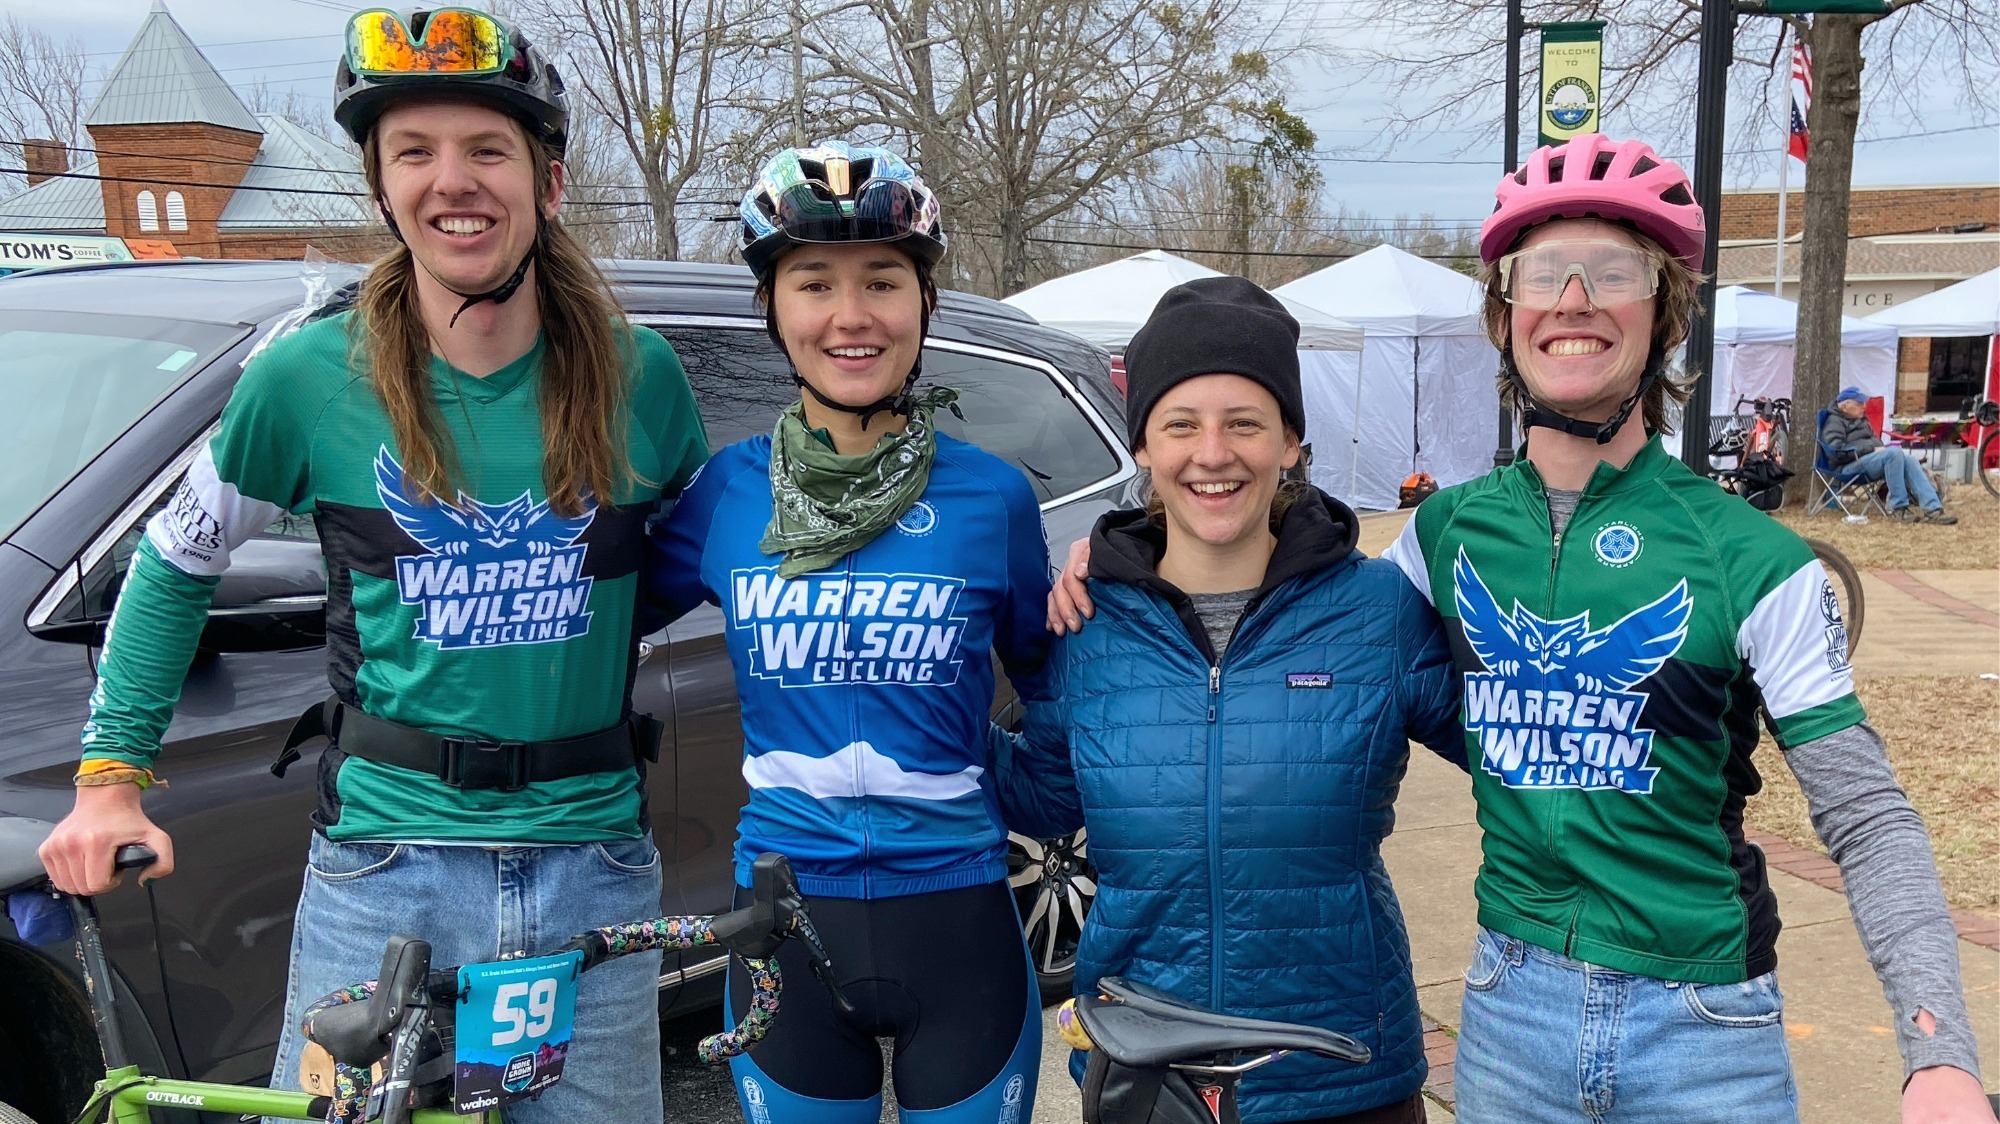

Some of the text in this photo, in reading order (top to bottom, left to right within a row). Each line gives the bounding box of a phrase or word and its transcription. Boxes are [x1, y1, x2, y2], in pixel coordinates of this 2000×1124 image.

[1547, 48, 1597, 56] WELCOME
[0, 242, 102, 261] TOM'S COFFEE
[1852, 293, 1894, 306] ICE
[180, 476, 225, 538] BERTY
[1597, 520, 1645, 541] STARLIGHT
[181, 547, 212, 562] 1980
[402, 552, 579, 598] WARREN
[735, 573, 955, 621] WARREN
[429, 585, 585, 636] WILSON
[469, 619, 569, 645] CYCLING
[760, 621, 958, 671] WILSON
[812, 661, 934, 682] CYCLING
[1291, 679, 1328, 687] patagonia
[1467, 680, 1636, 731] WARREN
[1484, 727, 1644, 771] WILSON
[1521, 765, 1625, 788] CYCLING
[491, 977, 558, 1046] 59
[508, 1065, 532, 1078] GROWN
[511, 1059, 532, 1071] HOME
[146, 1091, 205, 1106] OUTBACK
[460, 1095, 499, 1111] wahoo
